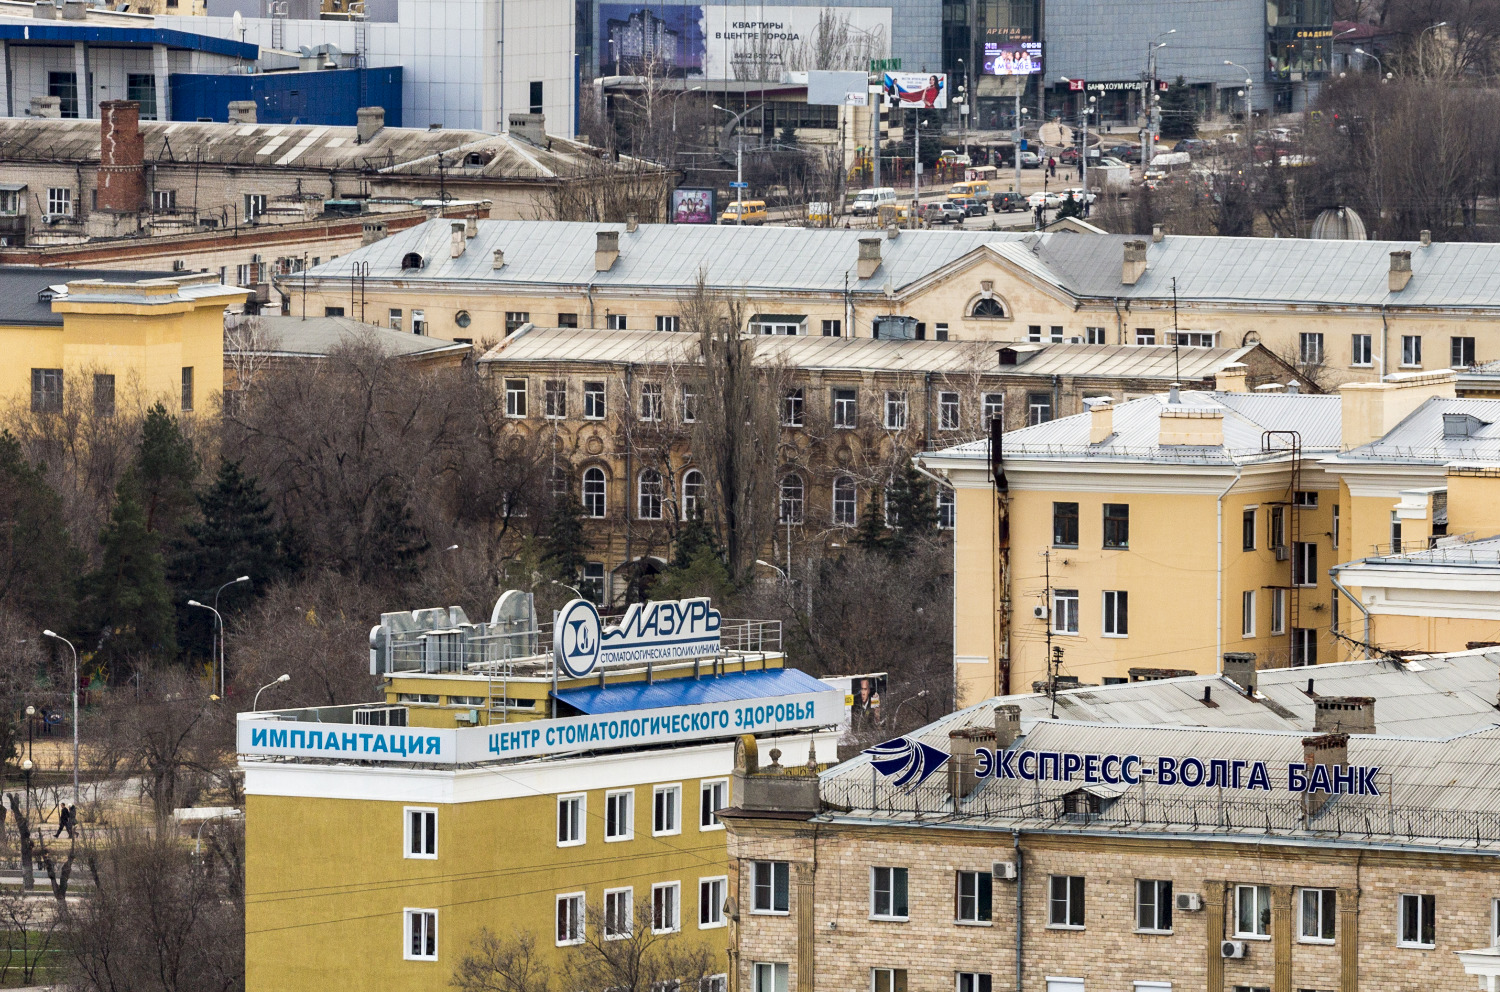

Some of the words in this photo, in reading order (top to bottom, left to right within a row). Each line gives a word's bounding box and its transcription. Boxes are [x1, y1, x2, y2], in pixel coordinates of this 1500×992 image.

[724, 32, 759, 40] ЦЕНТРЕ
[732, 21, 783, 29] КВАРТИРЫ
[1105, 82, 1124, 90] ХОУМ
[602, 600, 721, 640] ЛАЗУРЬ
[600, 647, 671, 664] СТОМАТОЛОГИЧЕСКАЯ
[672, 643, 720, 658] ПОЛИКЛИНИКА
[488, 728, 541, 756] ЦЕНТР
[545, 709, 730, 744] СТОМАТОЛОГИЧЕСКОГО
[734, 700, 815, 727] ЗДОРОВЬЯ
[251, 728, 441, 756] ИМПЛАНТАЦИЯ
[973, 747, 1273, 792] ЭКСПРЕСС-ВОЛГА
[1287, 762, 1382, 797] БАНК
